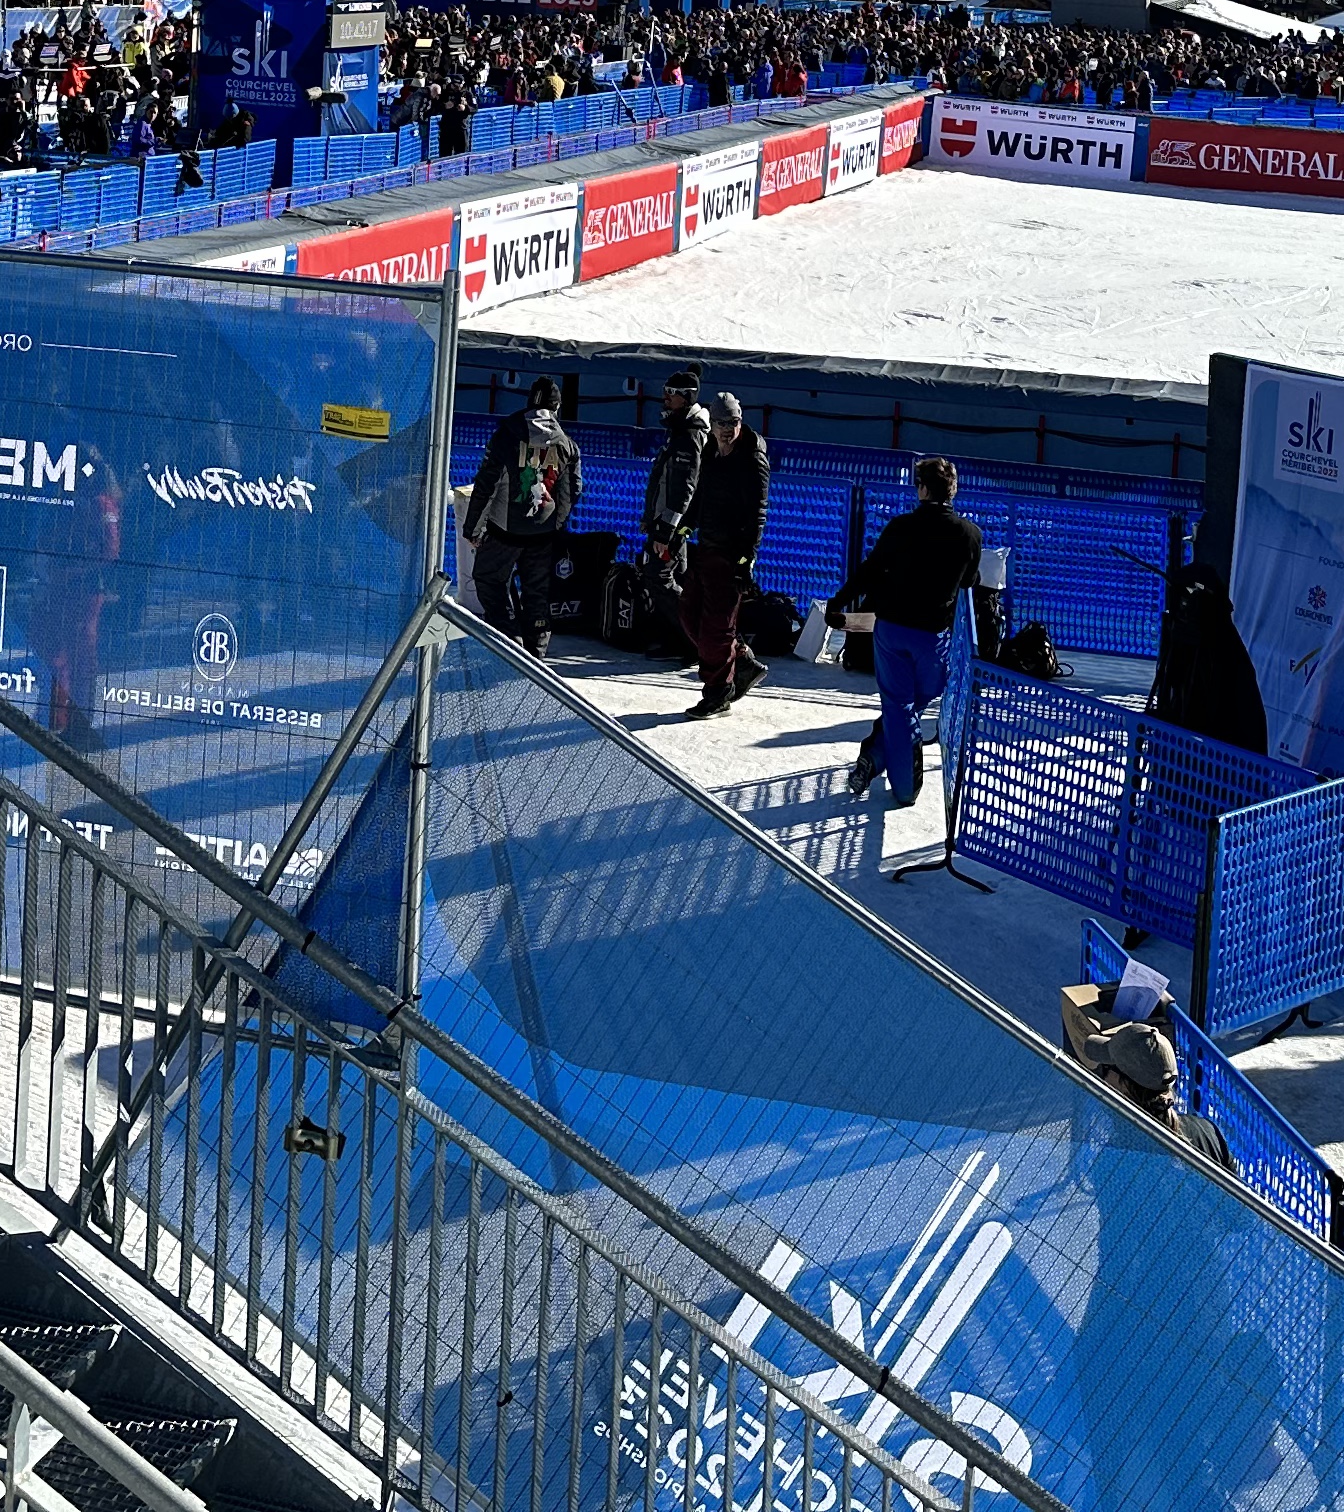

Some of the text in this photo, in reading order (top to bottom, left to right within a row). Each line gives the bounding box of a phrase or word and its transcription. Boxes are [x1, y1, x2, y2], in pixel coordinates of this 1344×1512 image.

[226, 79, 296, 92] COURCHEVEL
[270, 92, 296, 102] 2023
[843, 139, 877, 176] WÜRTH
[987, 130, 1123, 170] WÜRTH
[776, 146, 824, 191] GENERALI
[605, 190, 676, 245] GENERALI
[703, 177, 752, 226] WÜRTH
[493, 228, 570, 286] WÜRTH
[518, 440, 557, 470] ITA
[1282, 449, 1338, 469] COURCHEVEL
[549, 600, 581, 616] EA7
[618, 598, 631, 629] EA7
